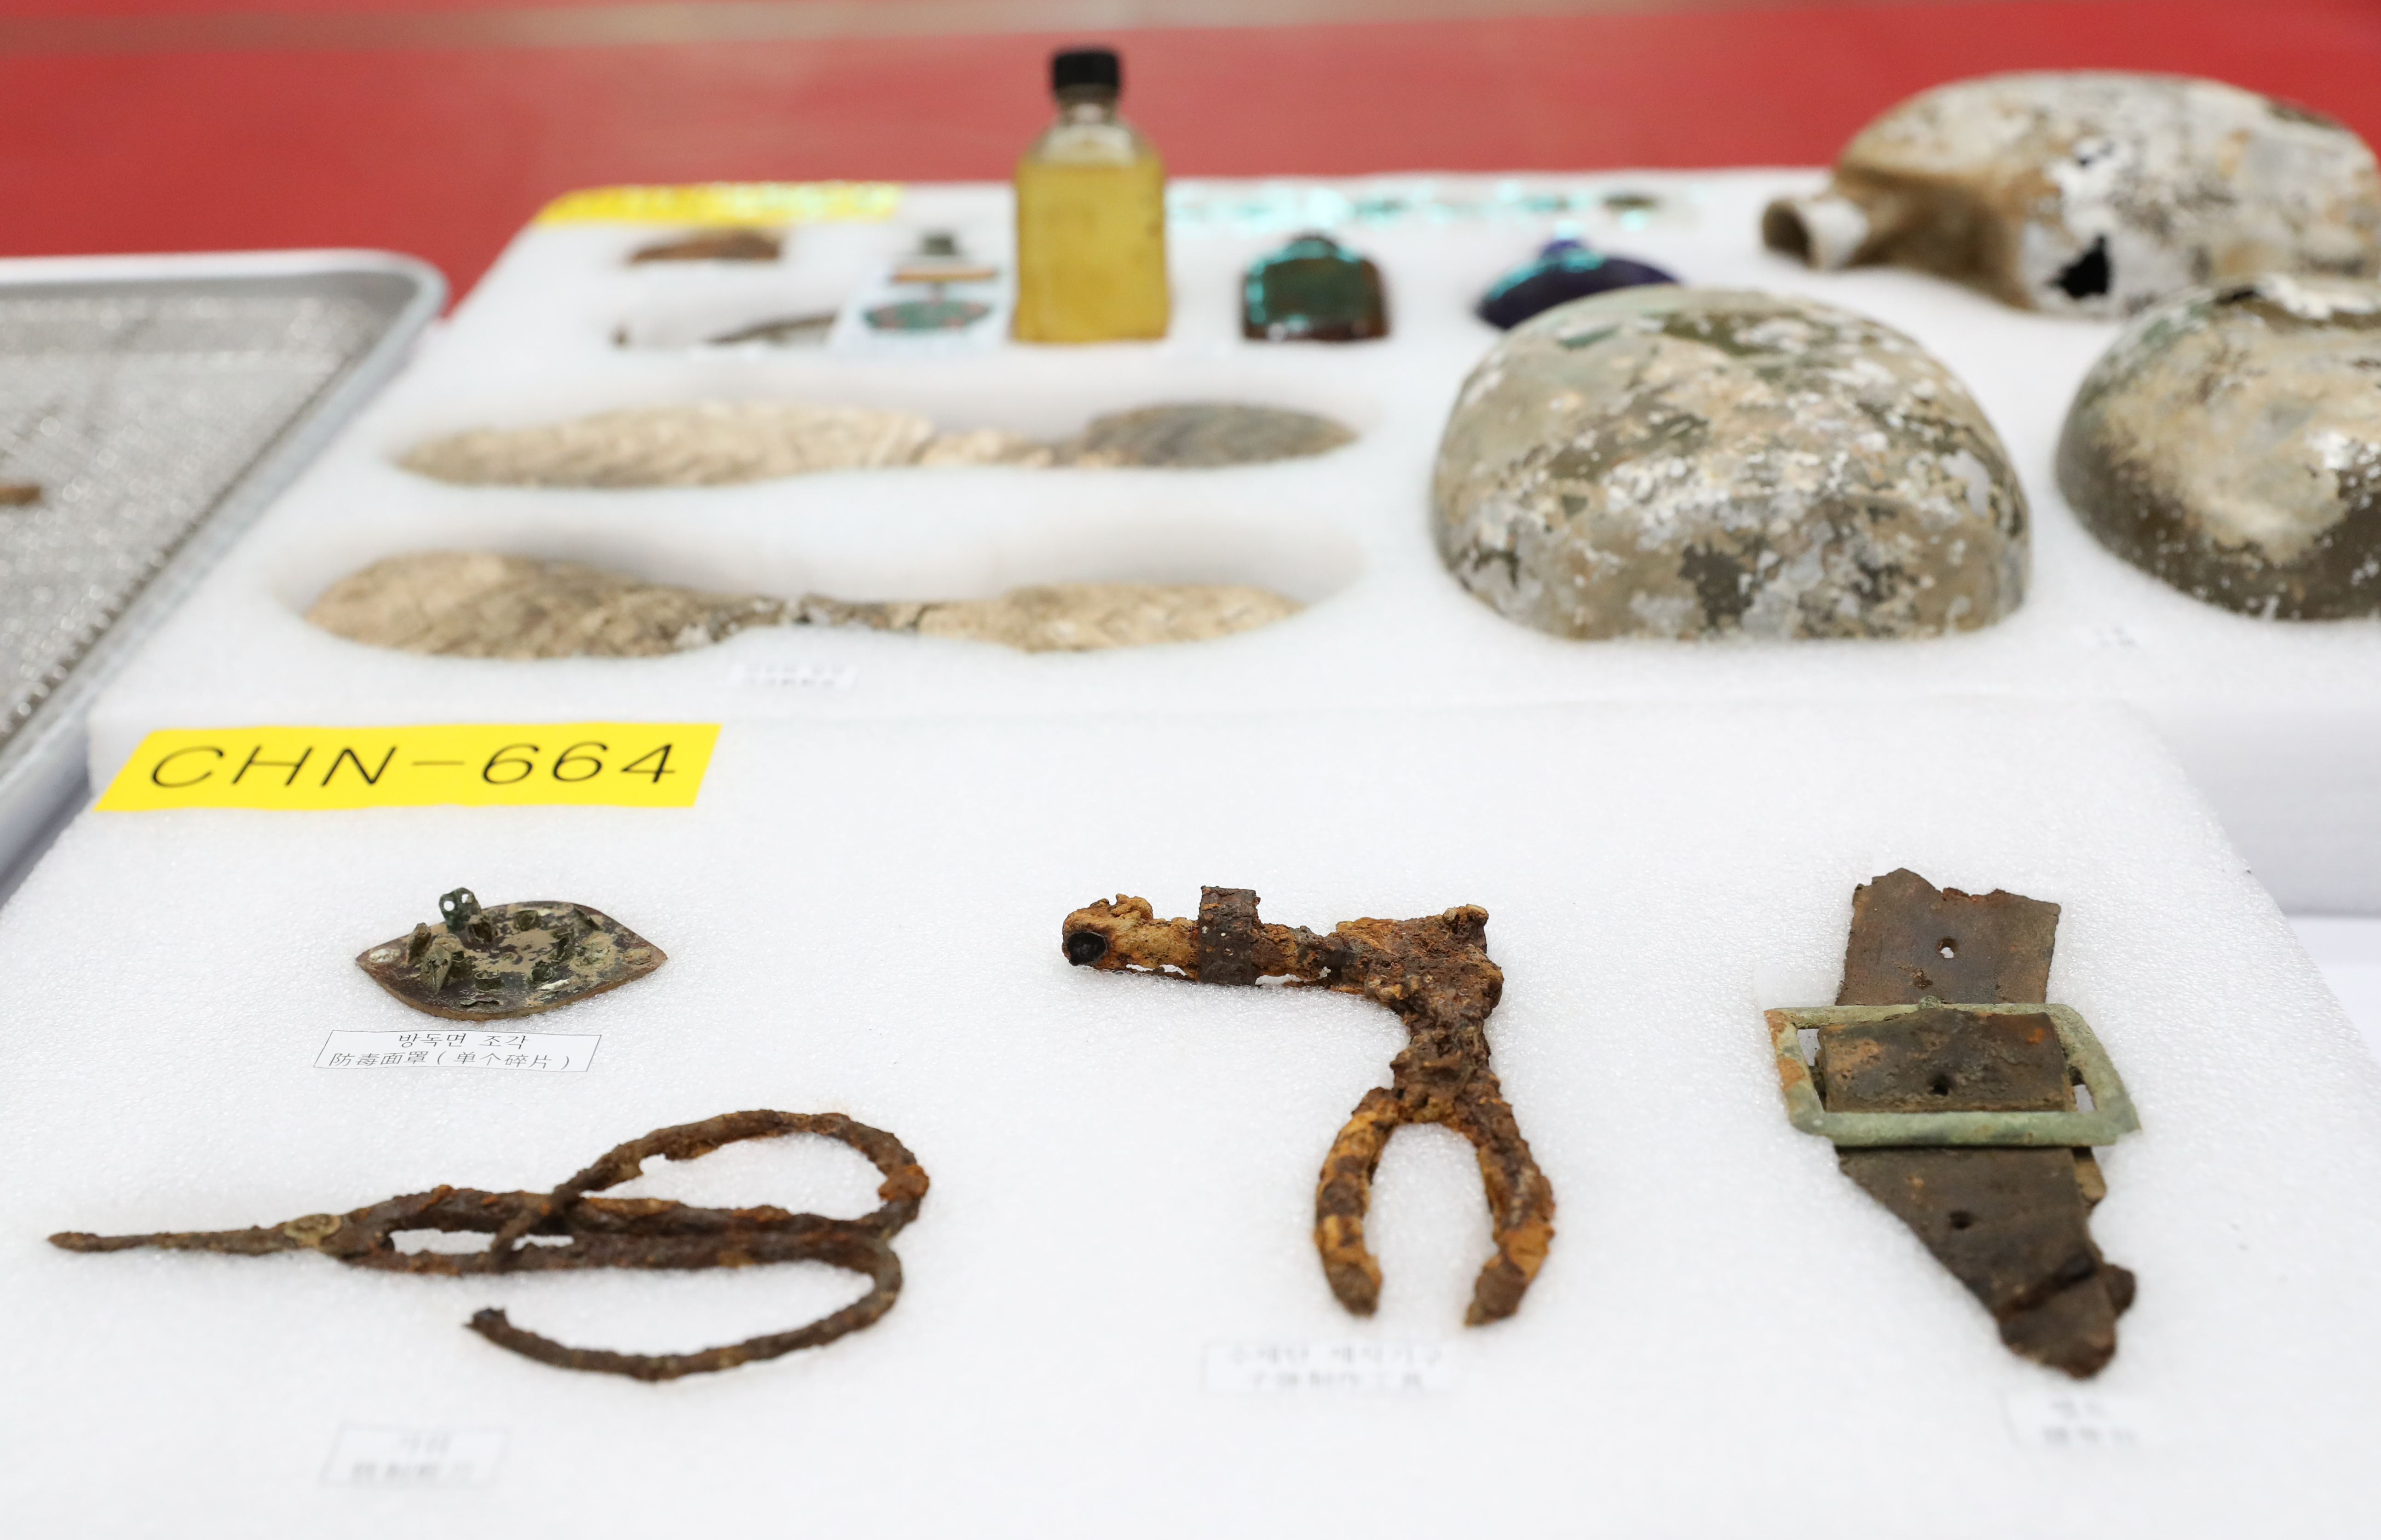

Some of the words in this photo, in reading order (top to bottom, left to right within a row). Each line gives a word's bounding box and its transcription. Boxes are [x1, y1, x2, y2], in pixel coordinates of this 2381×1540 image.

[151, 741, 675, 787] CHN-664
[399, 1033, 467, 1048] 방독면
[478, 1035, 529, 1049] 조각
